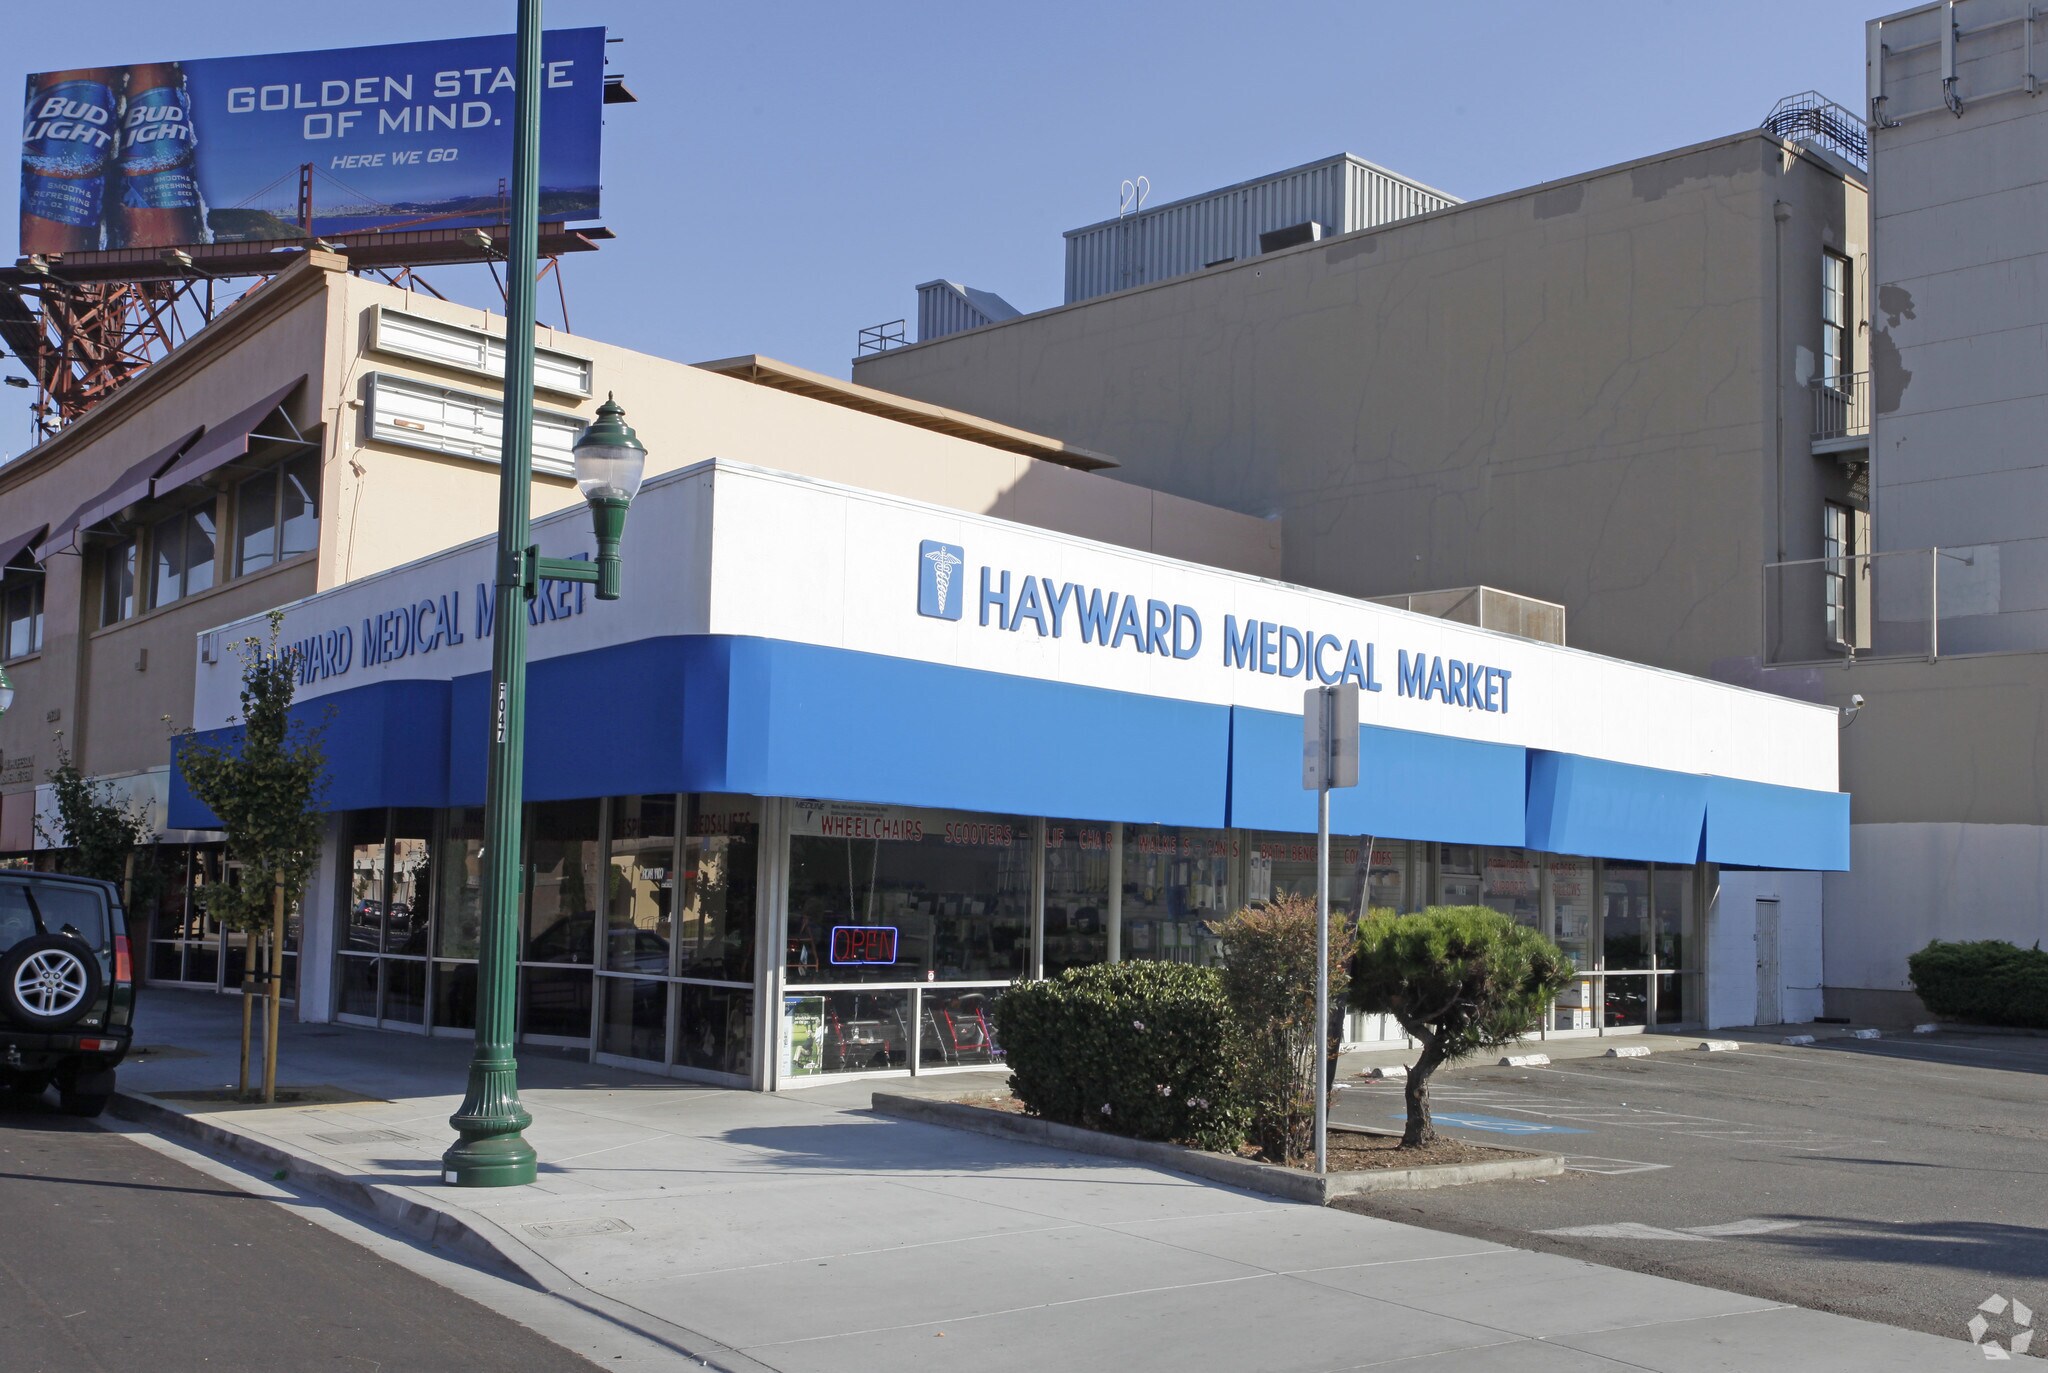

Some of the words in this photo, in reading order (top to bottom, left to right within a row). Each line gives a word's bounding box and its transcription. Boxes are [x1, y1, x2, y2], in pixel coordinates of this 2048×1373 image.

[227, 74, 412, 113] GOLDEN
[434, 60, 574, 98] STAE
[38, 97, 108, 126] BUD
[125, 105, 183, 128] BUD
[303, 110, 362, 140] OF
[379, 101, 501, 134] MIND.
[23, 121, 111, 148] LIGHT
[125, 124, 189, 148] IGHT
[331, 153, 385, 169] HERE
[392, 150, 423, 165] WE
[47, 182, 85, 196] SMOOTH
[153, 175, 184, 184] SMOOTH
[33, 190, 90, 208] REFRESHING
[246, 624, 353, 700] YWARD
[361, 590, 463, 668] MEDICAL
[475, 551, 588, 640] MKET
[980, 566, 1202, 661] HAYWARD
[1224, 614, 1382, 693] MEDICAL
[1399, 649, 1512, 715] MARKET
[498, 683, 506, 742] F047
[821, 815, 924, 841] WHEELCHAIRS
[944, 822, 1012, 847] SCOOTERS
[1261, 843, 1287, 862] BATH
[1344, 849, 1392, 866] COODES
[834, 929, 895, 961] OPEN
